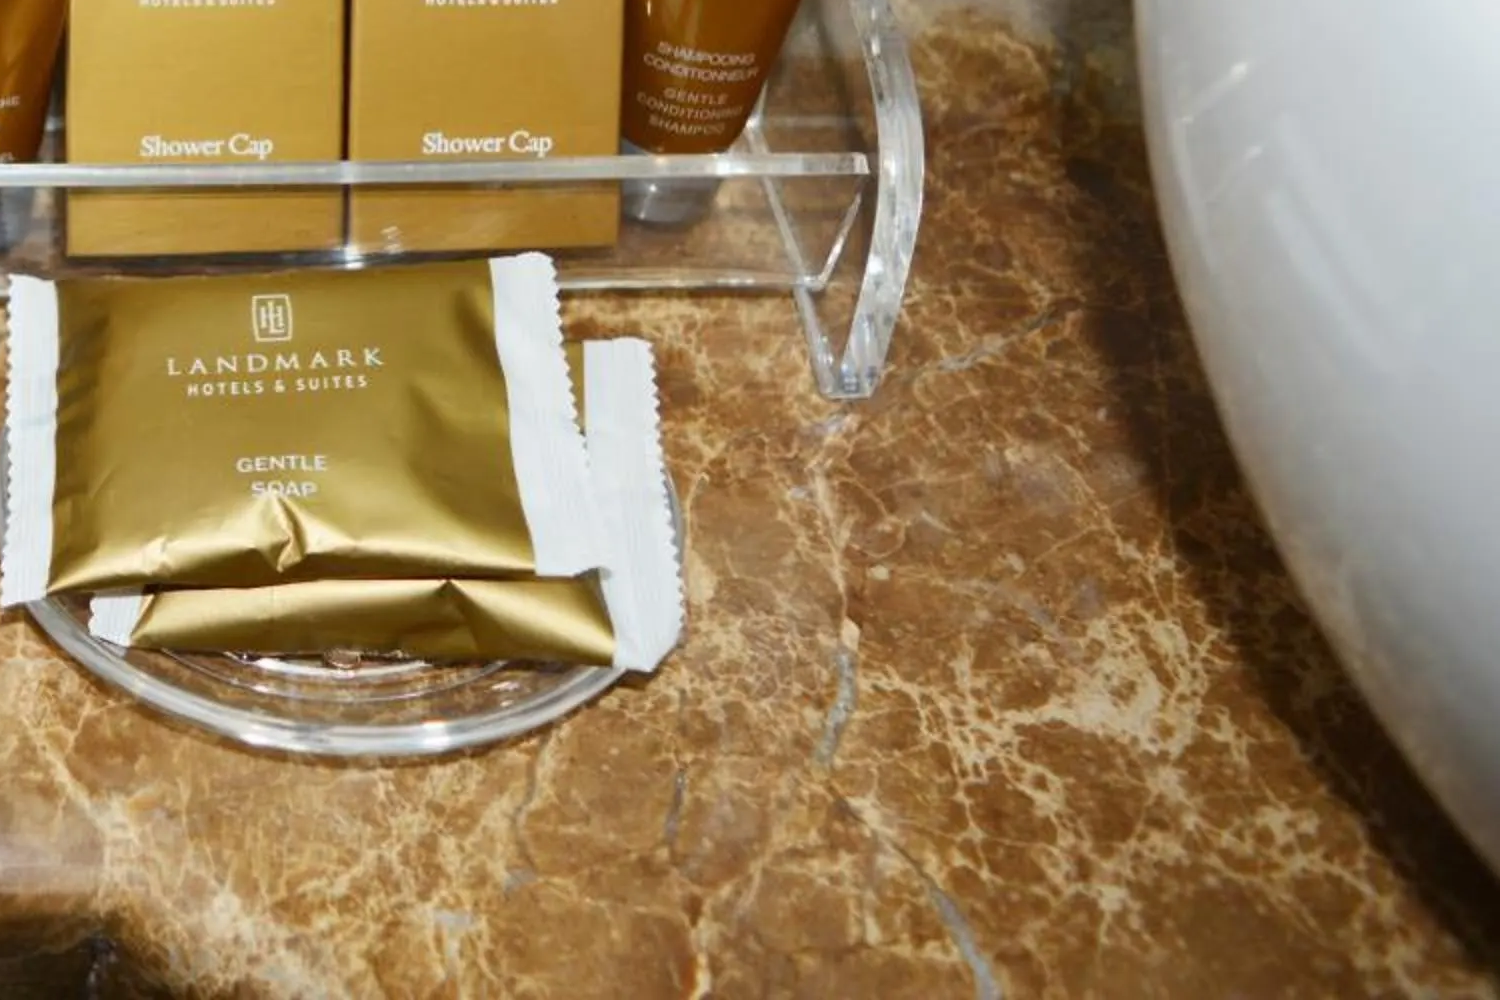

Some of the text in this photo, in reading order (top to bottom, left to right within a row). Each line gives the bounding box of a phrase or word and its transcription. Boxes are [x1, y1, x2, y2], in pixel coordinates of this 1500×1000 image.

[663, 87, 728, 104] GENTLE
[140, 133, 274, 160] Shower Cap
[422, 129, 553, 158] Shower Cap
[167, 347, 384, 376] LANDMARK
[187, 375, 367, 396] HOTELS & SUITES
[236, 455, 328, 473] GENTLE
[251, 481, 318, 498] SOAP
